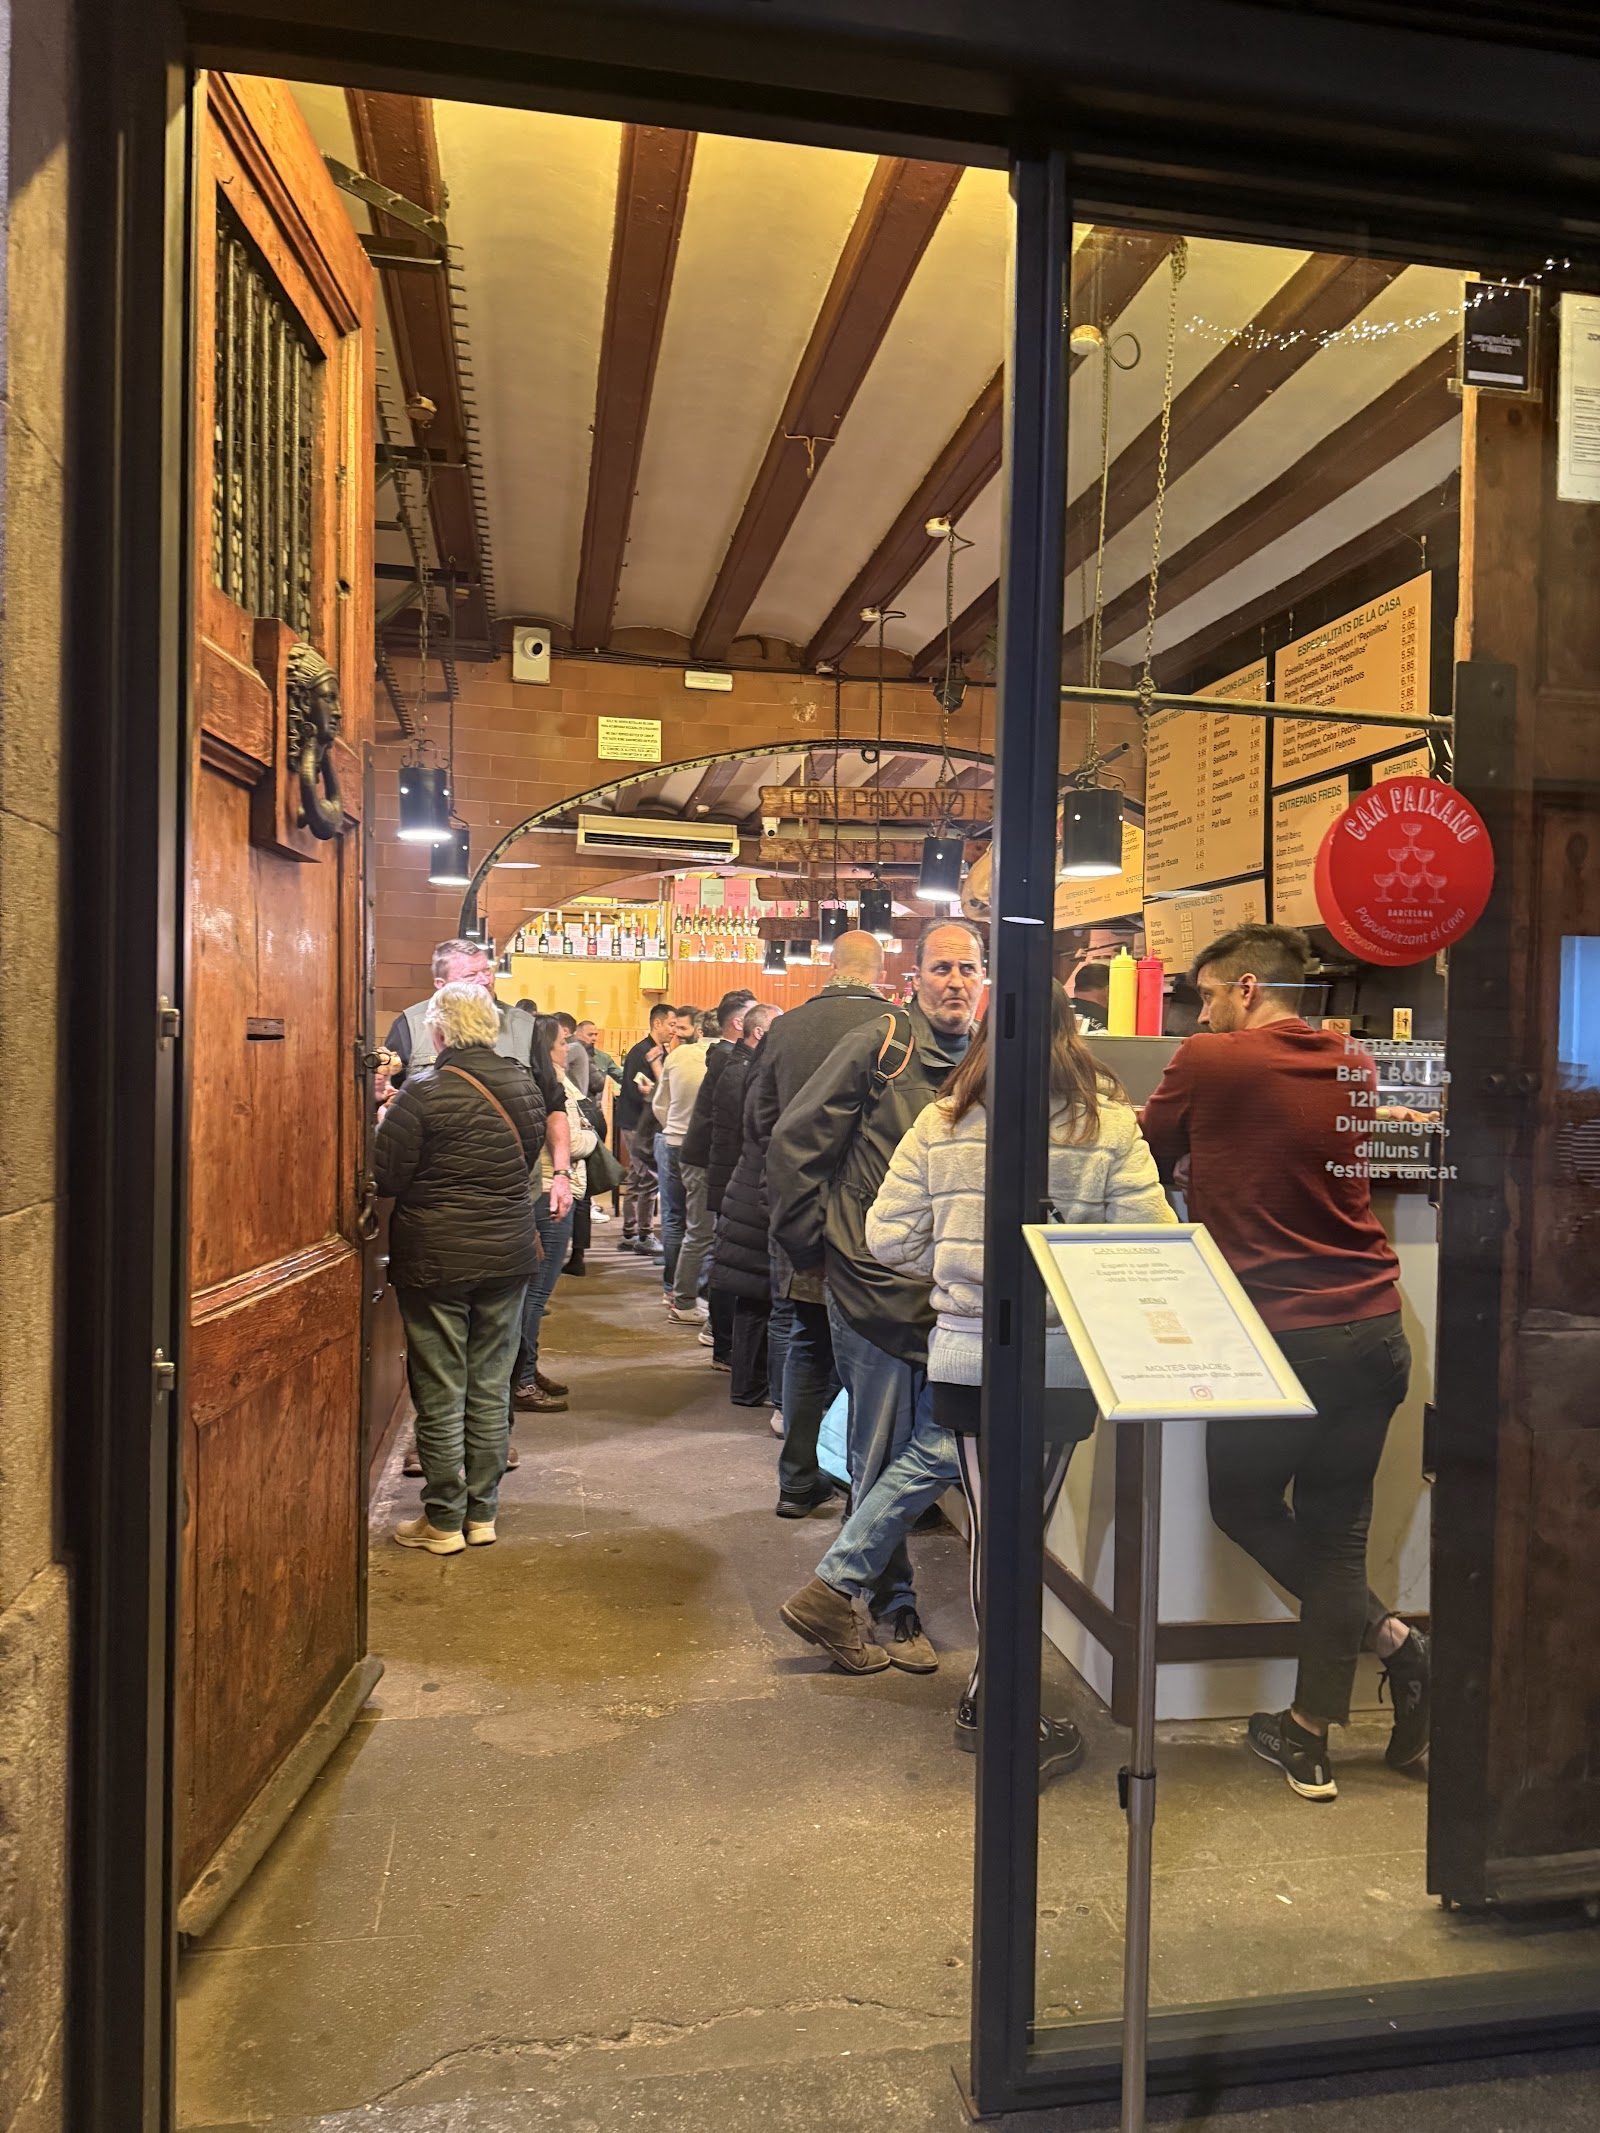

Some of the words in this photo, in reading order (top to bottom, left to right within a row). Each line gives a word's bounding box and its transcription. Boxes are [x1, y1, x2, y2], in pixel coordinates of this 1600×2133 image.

[1298, 621, 1351, 657] ESPECIALITATS
[1353, 615, 1363, 629] DE
[1366, 608, 1376, 622] LA
[1378, 596, 1400, 617] CASA
[790, 789, 835, 815] CAN
[853, 789, 966, 817] PAIXANO
[1279, 791, 1316, 812] ENTREPANS
[1318, 784, 1341, 801] FREDS
[1344, 794, 1388, 841] CAN
[1389, 785, 1480, 844] PAIXANO
[1355, 906, 1429, 945] Popularitzant
[1430, 930, 1442, 943] el
[1442, 908, 1466, 933] Cava
[1336, 1065, 1370, 1082] Bar
[1388, 1067, 1451, 1086] Botga
[1348, 1091, 1380, 1107] 12h
[1387, 1096, 1397, 1107] a
[1335, 1116, 1450, 1136] Diumenges,
[1354, 1141, 1419, 1158] dilluns
[1325, 1160, 1391, 1178] festius
[1396, 1165, 1457, 1179] tancat
